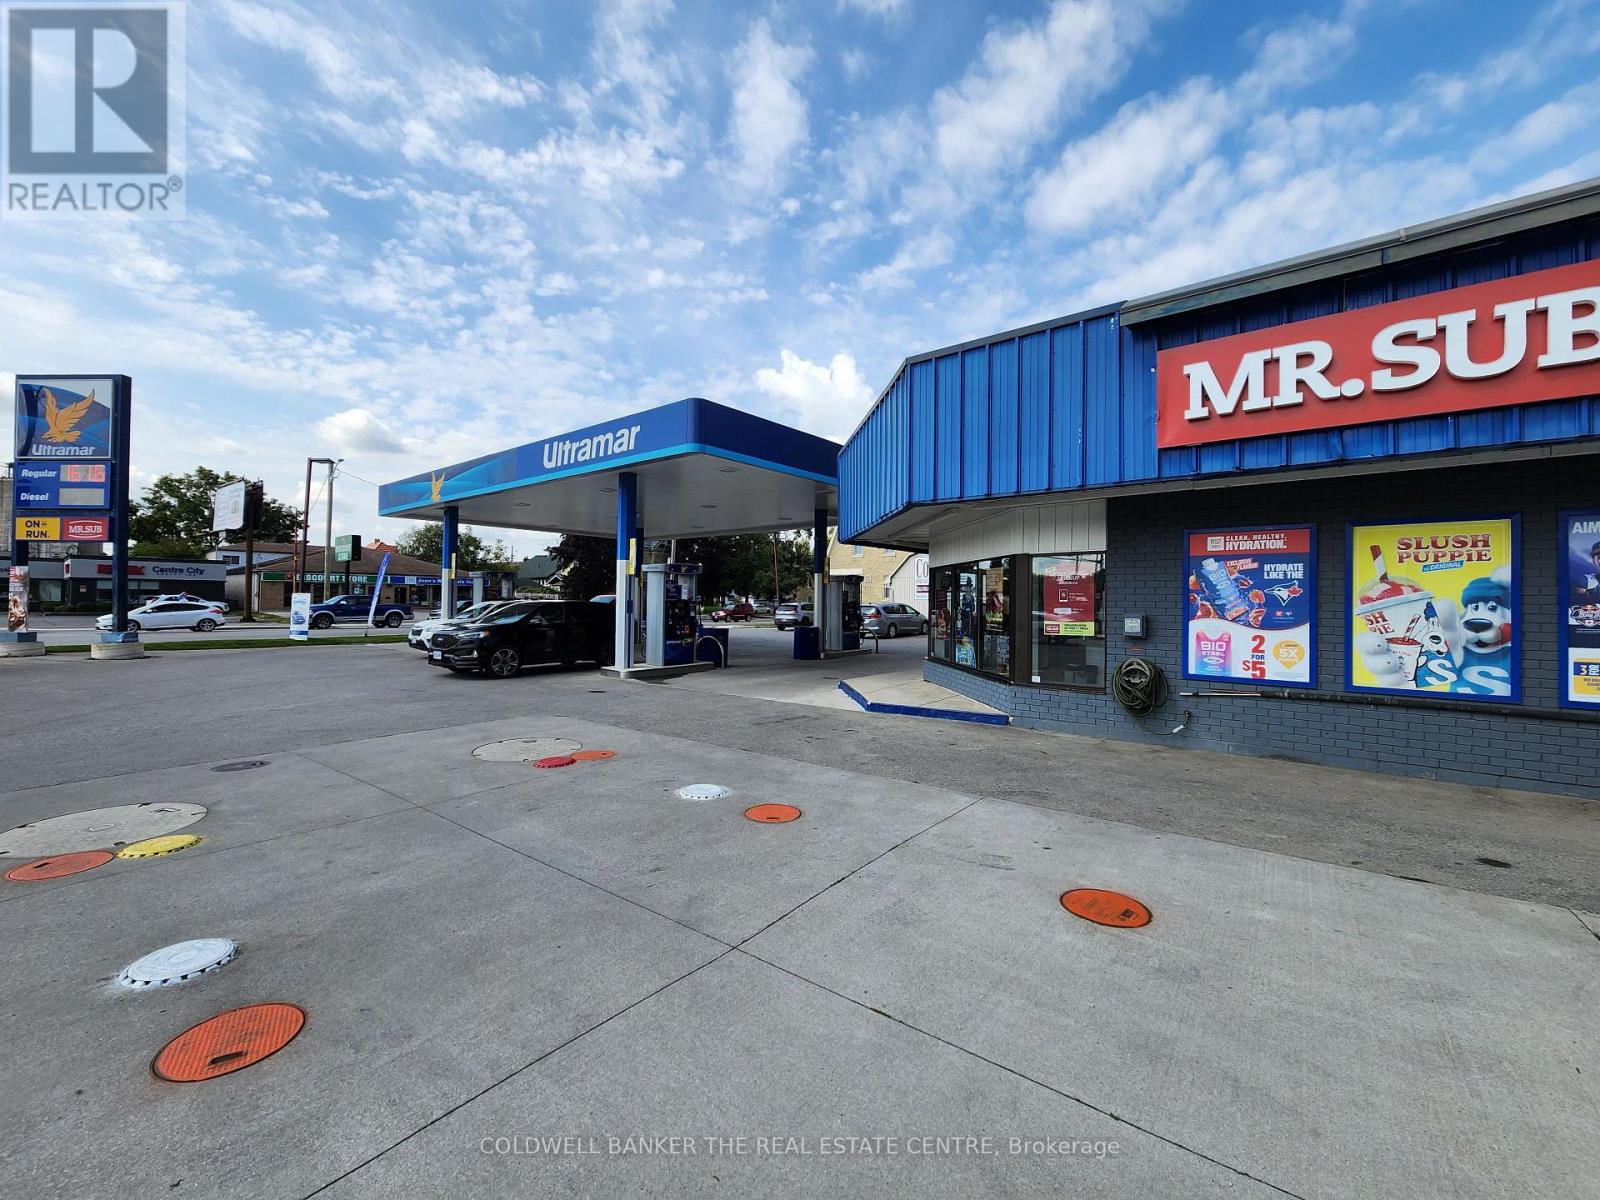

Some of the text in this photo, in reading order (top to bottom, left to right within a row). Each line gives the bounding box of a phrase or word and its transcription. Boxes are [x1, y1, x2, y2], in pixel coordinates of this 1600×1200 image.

[32, 444, 95, 456] Ultramar
[543, 424, 640, 469] Ultramar
[21, 469, 57, 479] Regular
[20, 493, 49, 501] Diesel
[25, 520, 40, 528] ON
[1396, 534, 1491, 551] SLUSH
[152, 566, 184, 574] Centre
[186, 567, 205, 576] City
[1264, 563, 1304, 571] HYDRATE
[1264, 571, 1304, 579] LIKE THE
[1201, 641, 1226, 651] BIO
[1251, 635, 1265, 654] 2
[1580, 664, 1588, 676] 3
